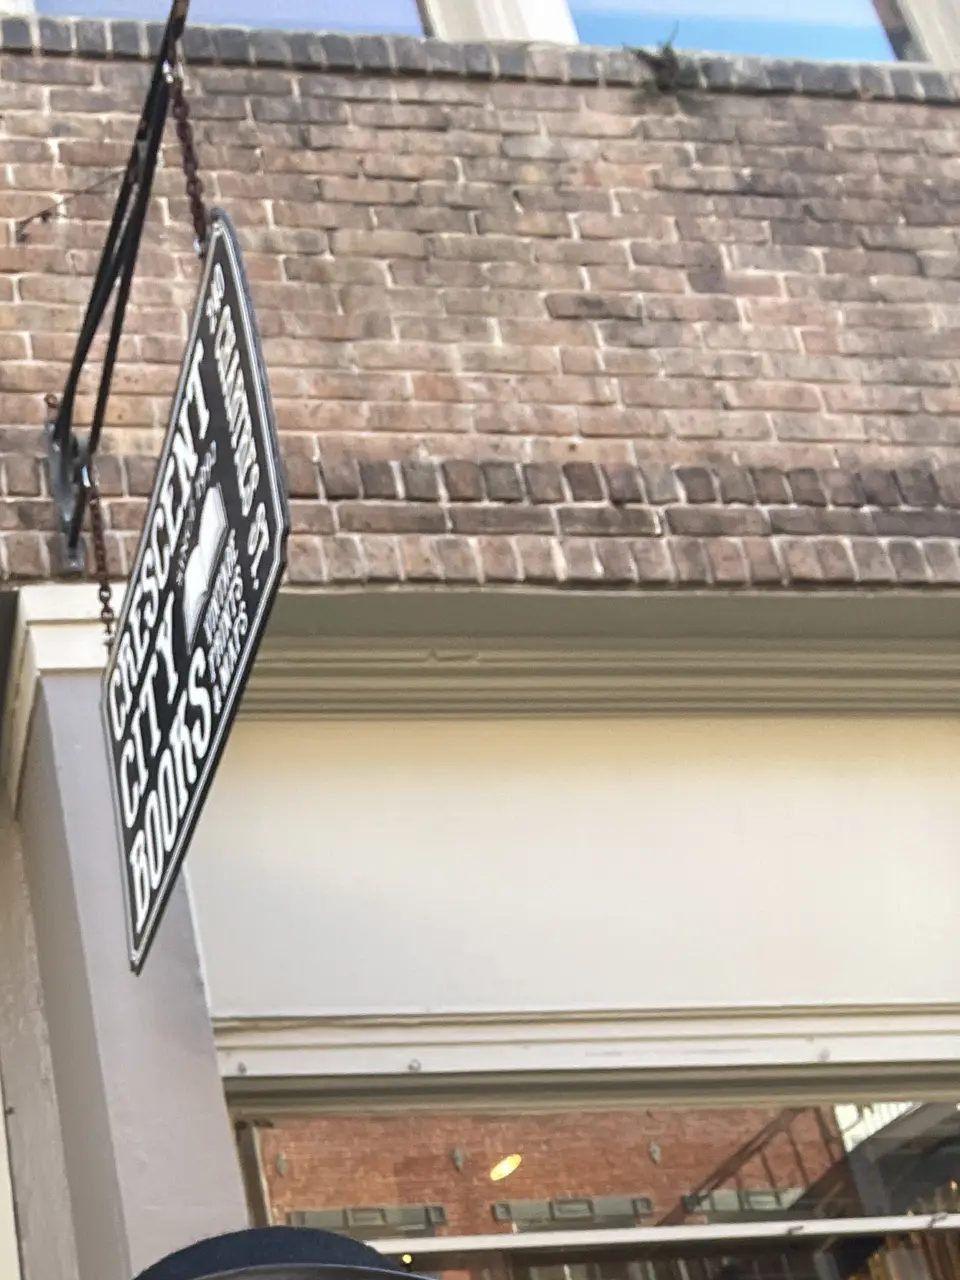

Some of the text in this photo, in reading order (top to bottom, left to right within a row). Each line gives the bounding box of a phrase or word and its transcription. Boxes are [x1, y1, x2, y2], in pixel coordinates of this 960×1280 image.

[108, 337, 211, 742] CRESCENT
[207, 563, 244, 683] PRINTS
[218, 599, 249, 696] MAPS
[119, 589, 179, 829] CITY
[128, 645, 213, 935] BOOKS
